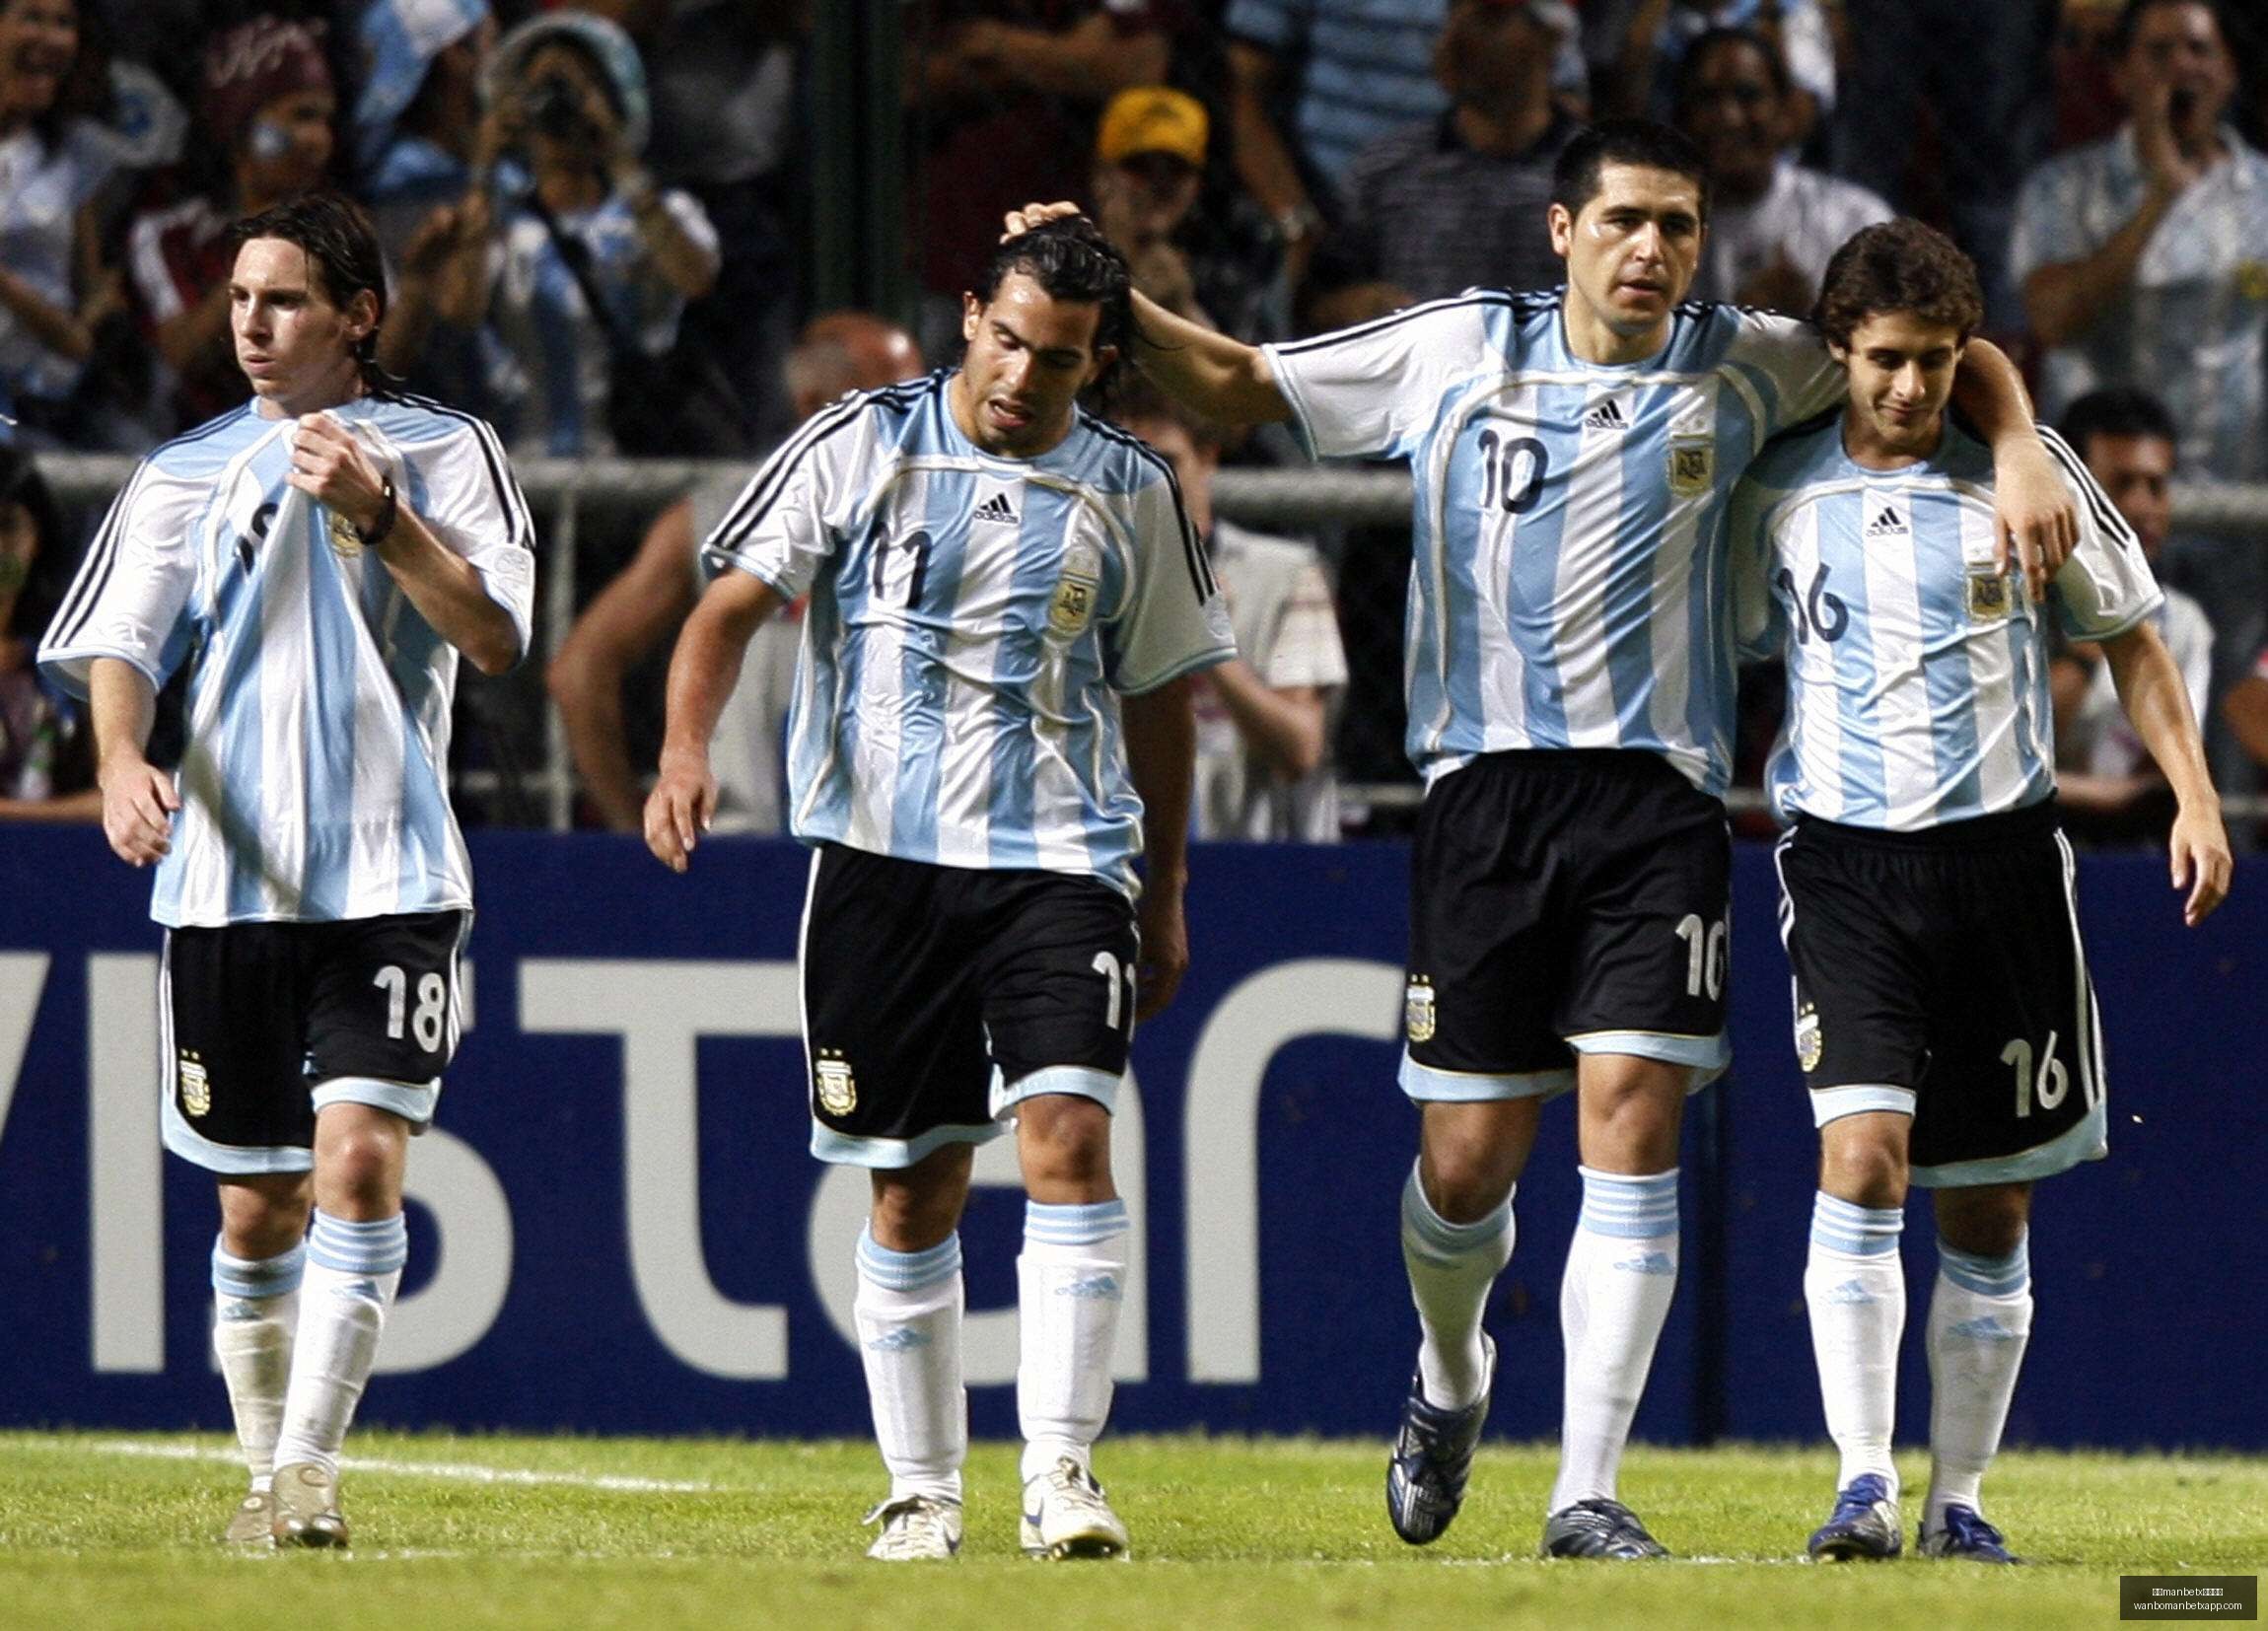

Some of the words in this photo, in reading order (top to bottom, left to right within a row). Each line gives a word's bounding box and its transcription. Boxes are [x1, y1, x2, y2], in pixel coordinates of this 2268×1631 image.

[1478, 429, 1549, 514] 10
[873, 522, 933, 609] 11
[1776, 562, 1849, 645] 16
[374, 965, 445, 1053] 18
[2000, 1029, 2068, 1117] 16
